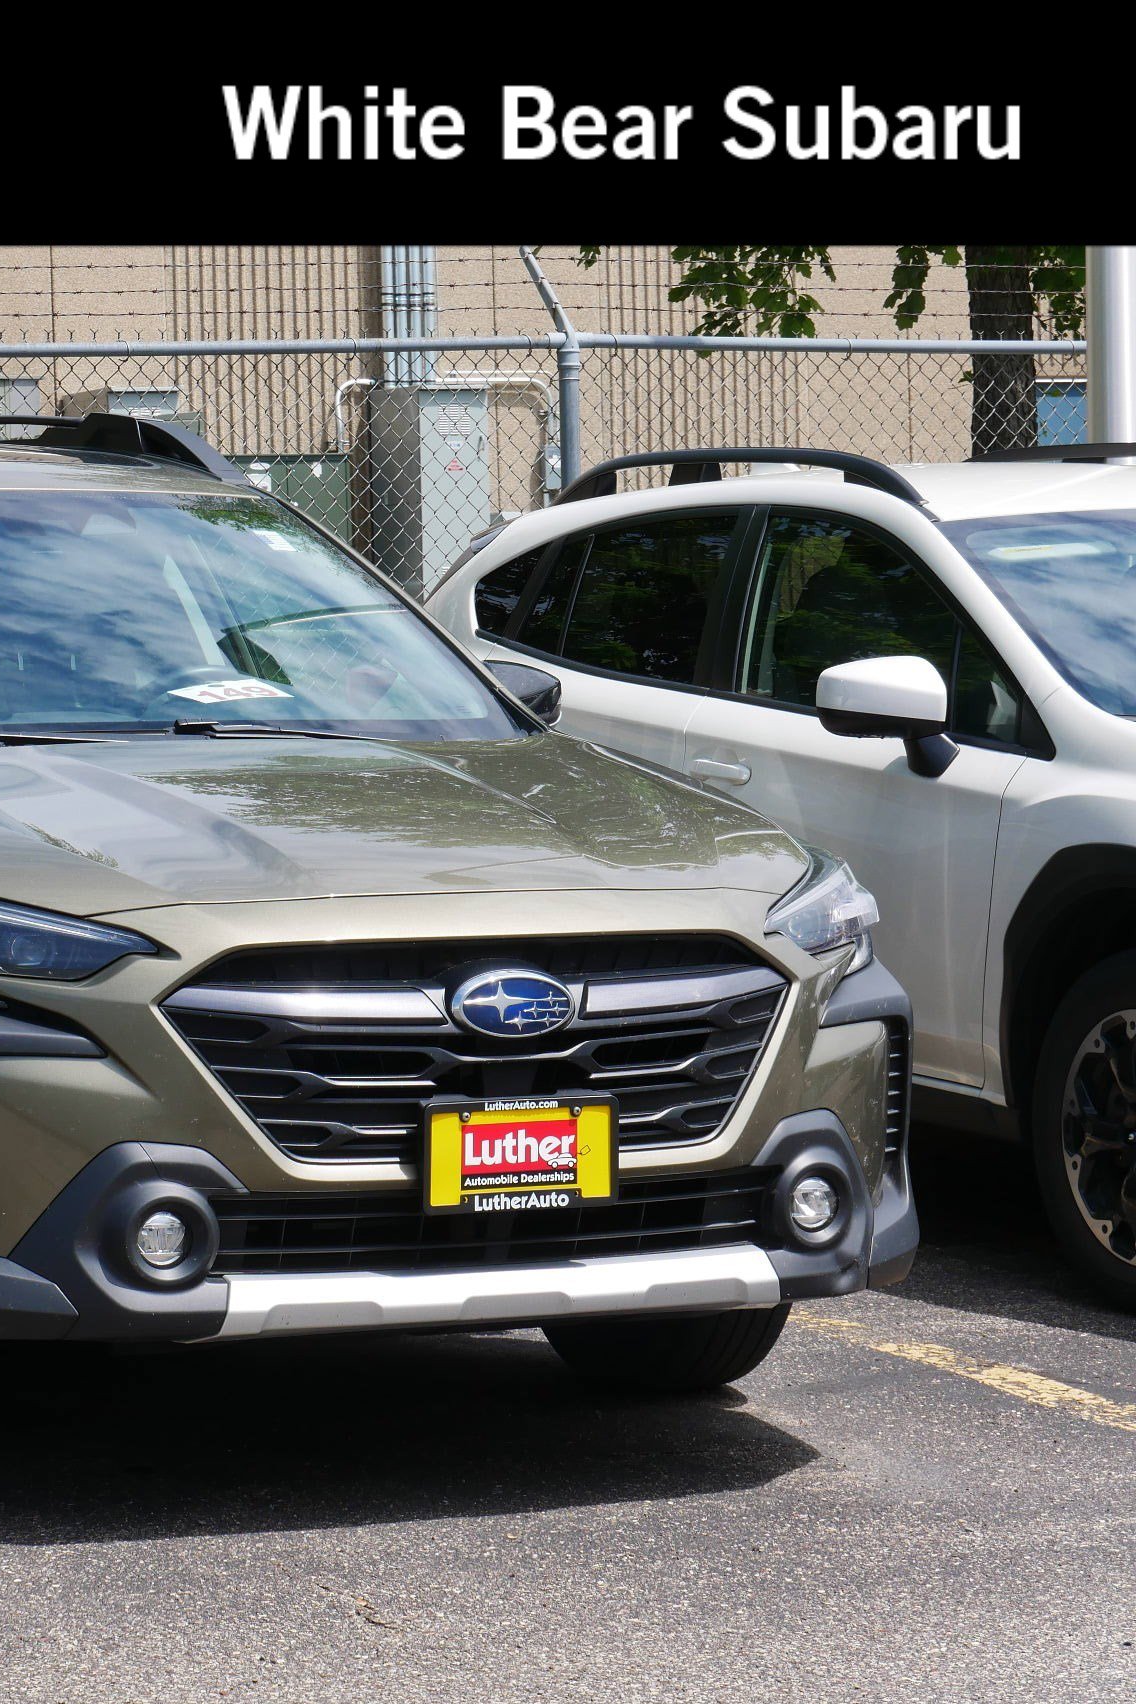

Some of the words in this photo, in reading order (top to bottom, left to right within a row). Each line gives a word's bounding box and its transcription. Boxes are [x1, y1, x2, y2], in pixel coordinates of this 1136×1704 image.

[198, 686, 278, 700] 149
[484, 1100, 559, 1111] LutherAuto.com
[464, 1129, 576, 1166] Luther
[464, 1174, 519, 1187] Automobile
[520, 1172, 575, 1184] Dealerships
[474, 1192, 570, 1212] LutherAuto
